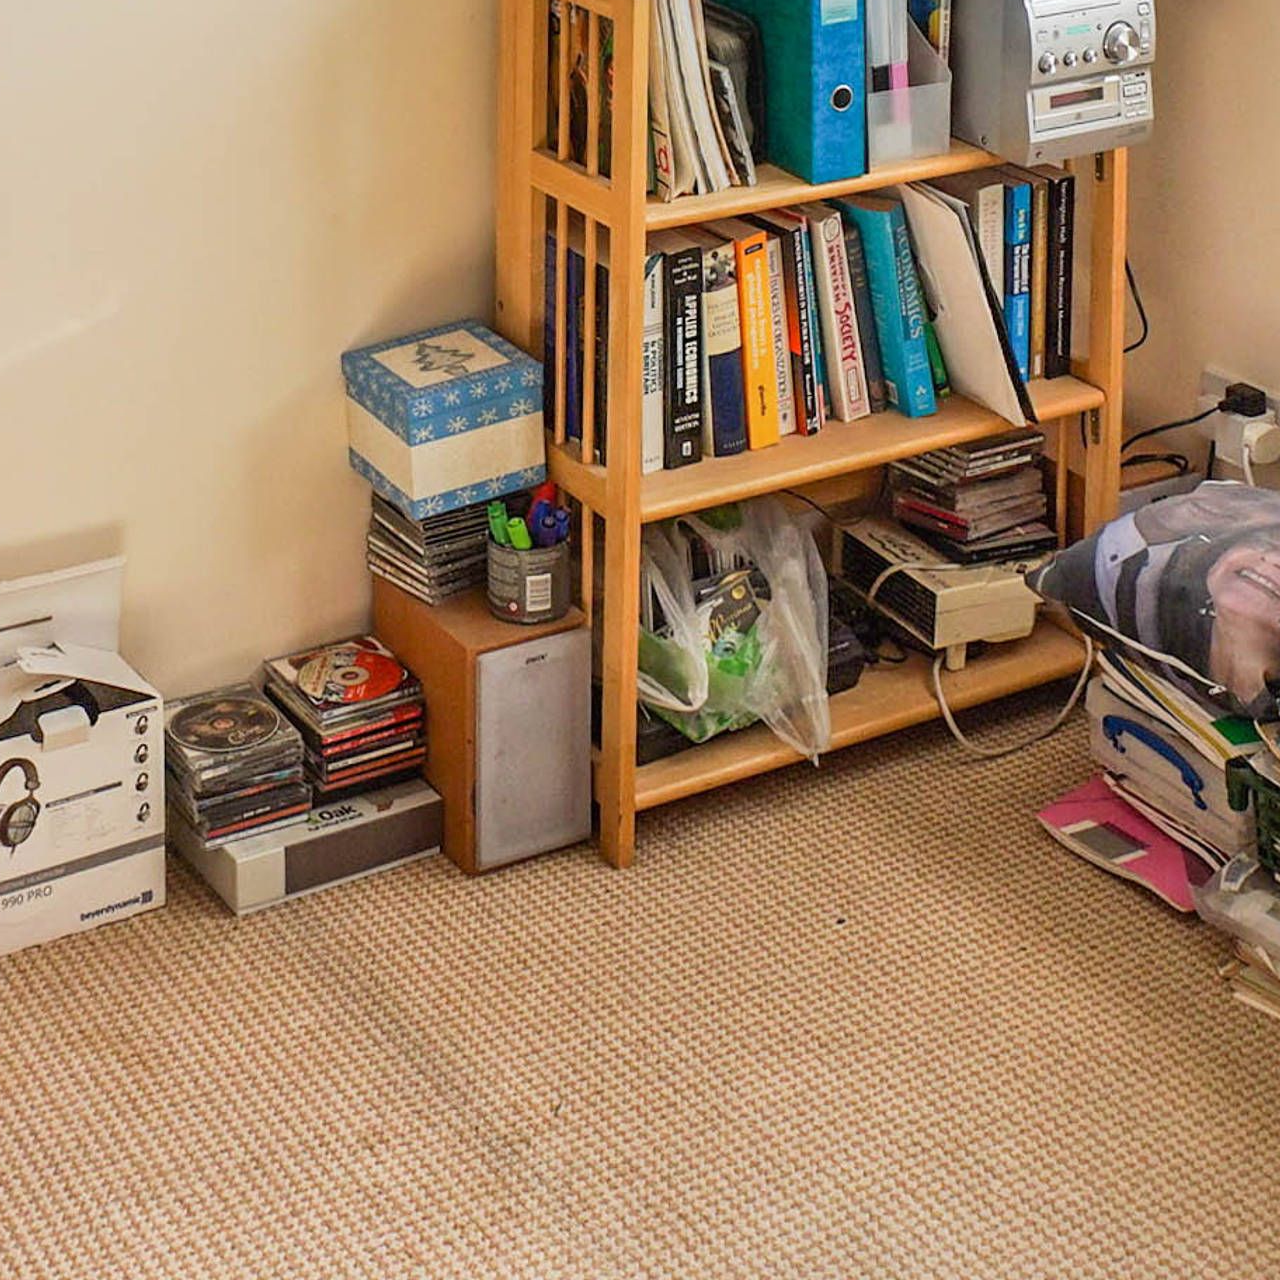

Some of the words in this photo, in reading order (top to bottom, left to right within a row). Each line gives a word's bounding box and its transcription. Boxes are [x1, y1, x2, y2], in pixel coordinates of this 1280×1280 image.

[684, 294, 698, 339] APPLIED
[835, 302, 858, 363] SOCIETY
[684, 341, 699, 405] ECONOMICS
[318, 805, 357, 821] Oak
[0, 895, 24, 911] 990
[26, 884, 54, 902] PRO
